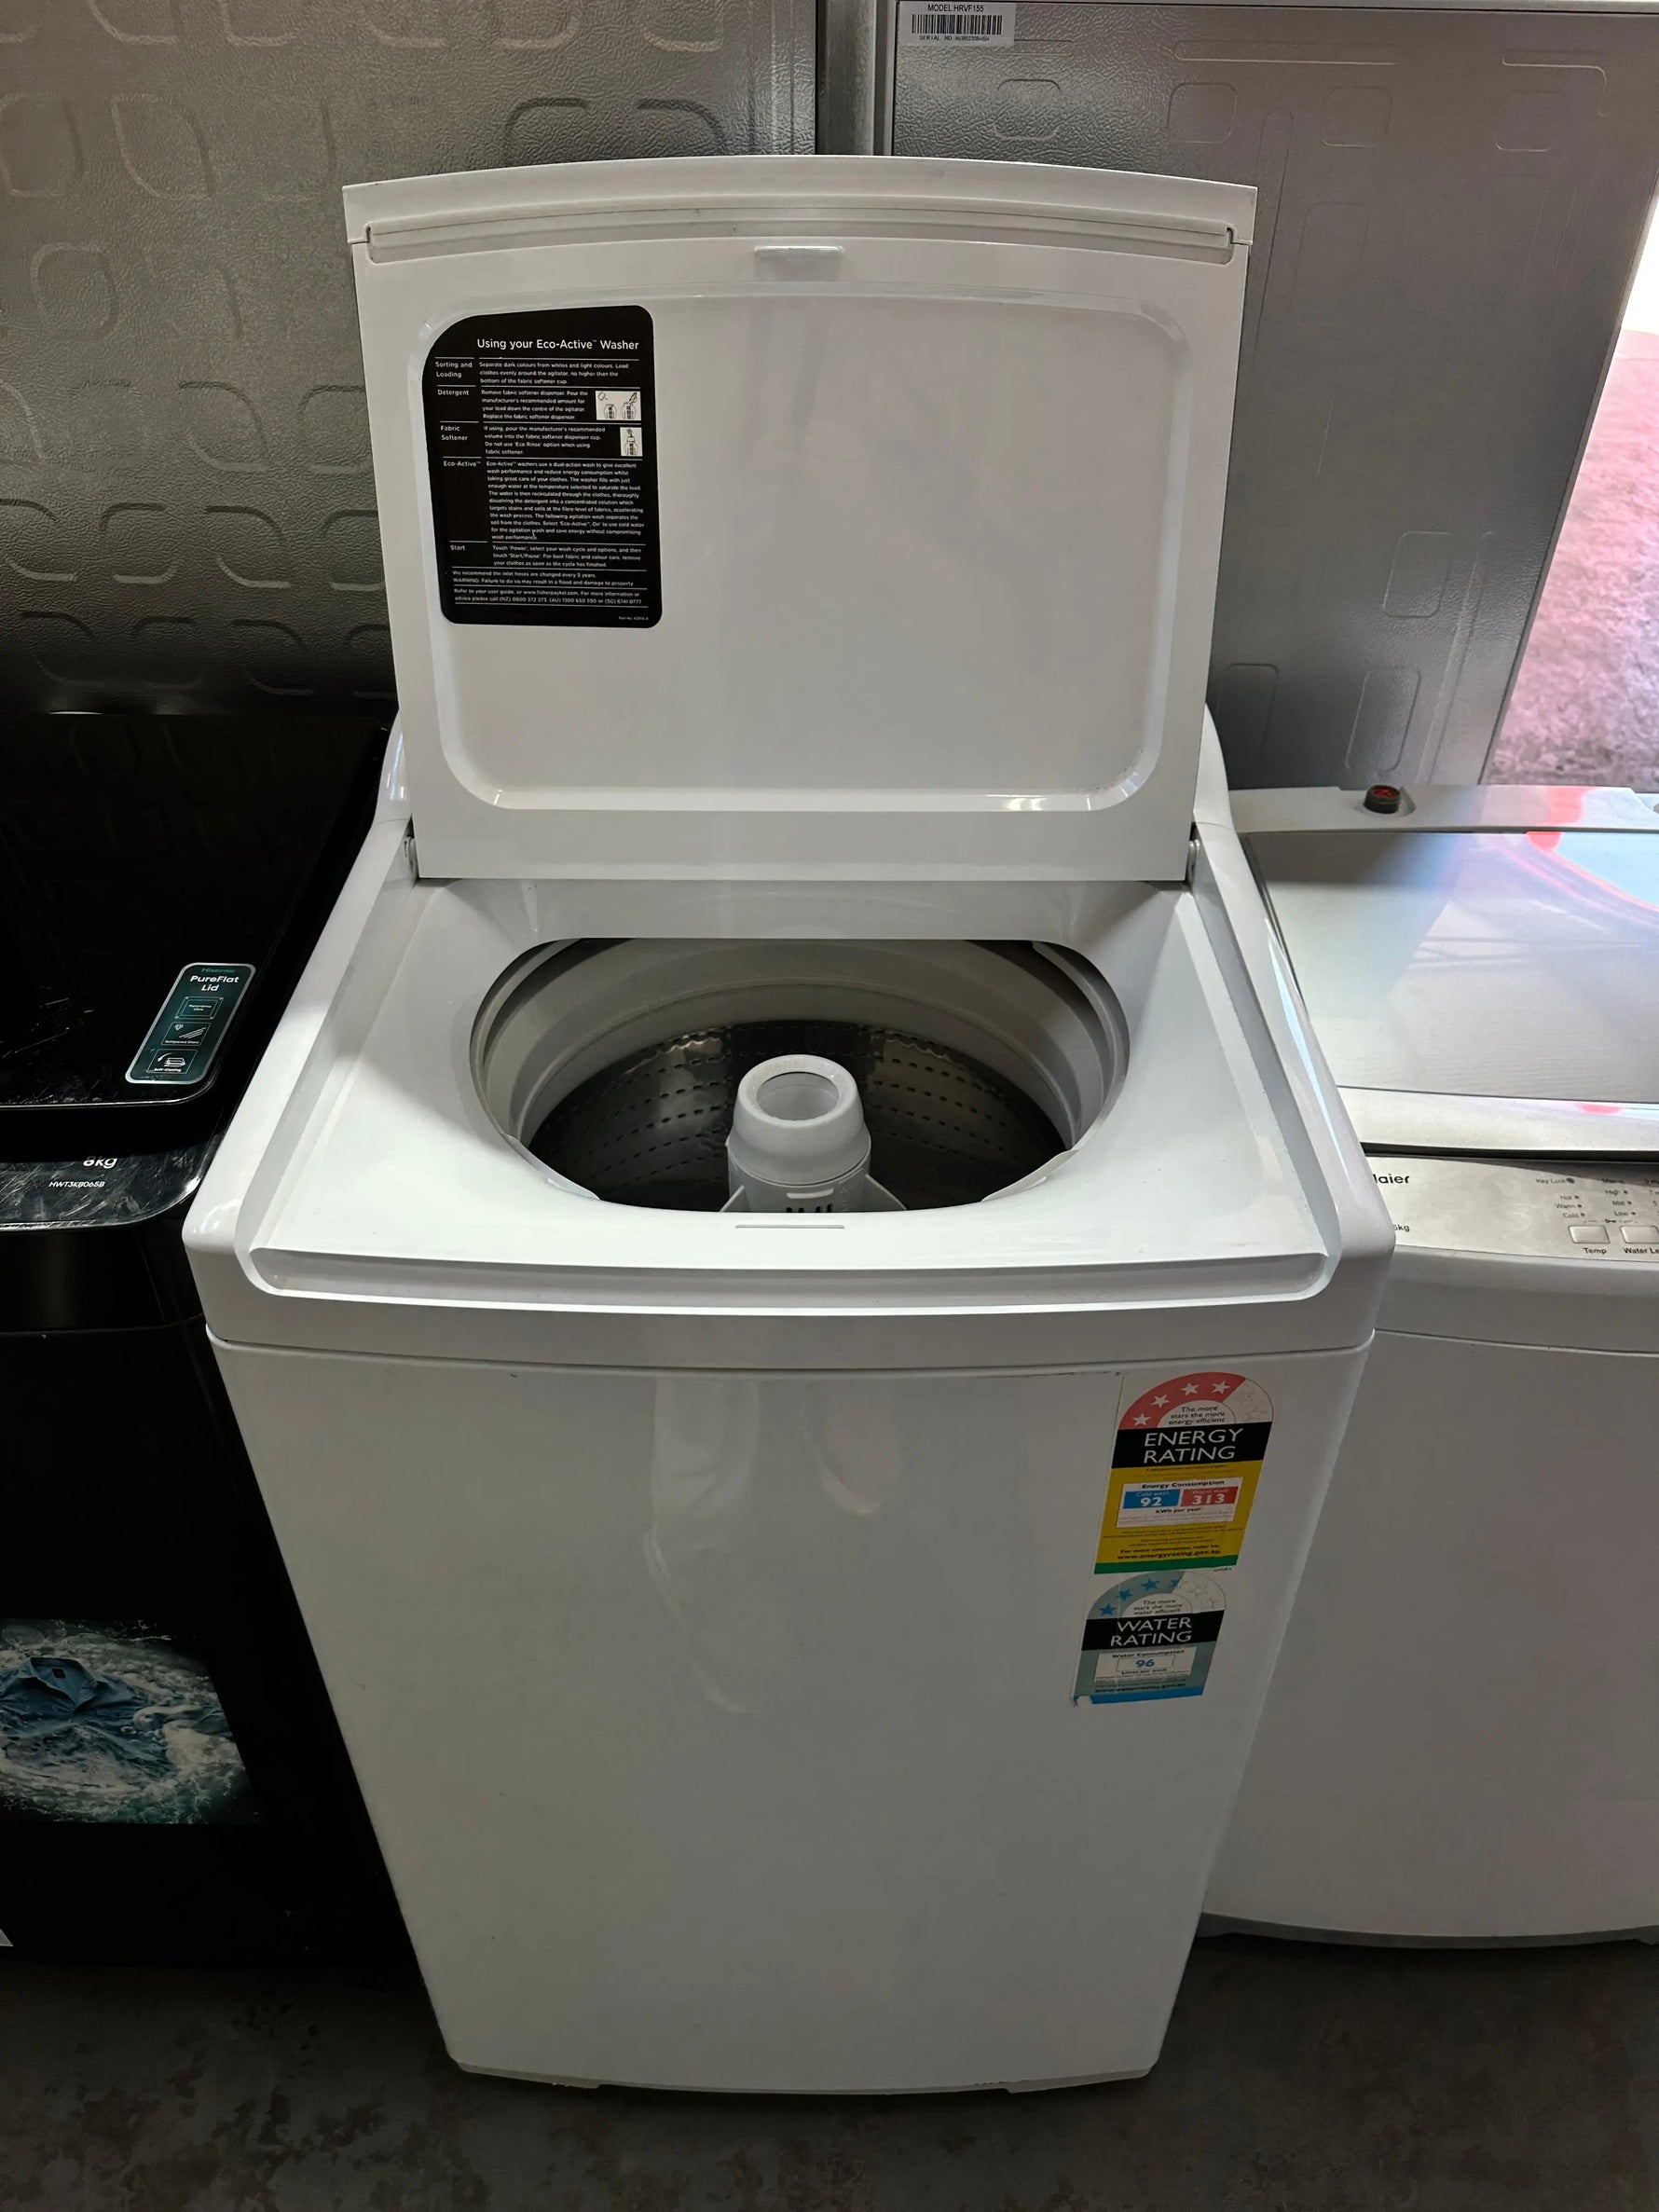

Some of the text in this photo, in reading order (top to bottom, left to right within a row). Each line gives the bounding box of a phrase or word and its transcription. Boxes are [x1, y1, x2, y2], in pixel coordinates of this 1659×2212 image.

[477, 338, 506, 350] Using
[510, 341, 533, 350] your
[600, 339, 640, 349] Washer
[83, 1156, 118, 1169] 8kg
[1145, 1428, 1244, 1447] ENERGY
[1143, 1446, 1236, 1464] RATING
[1172, 1480, 1225, 1488] Consumption
[1140, 1497, 1162, 1507] 92
[1192, 1493, 1225, 1505] 313
[1117, 1617, 1192, 1632] WATER
[1110, 1630, 1192, 1647] RATING
[1136, 1659, 1155, 1668] 96
